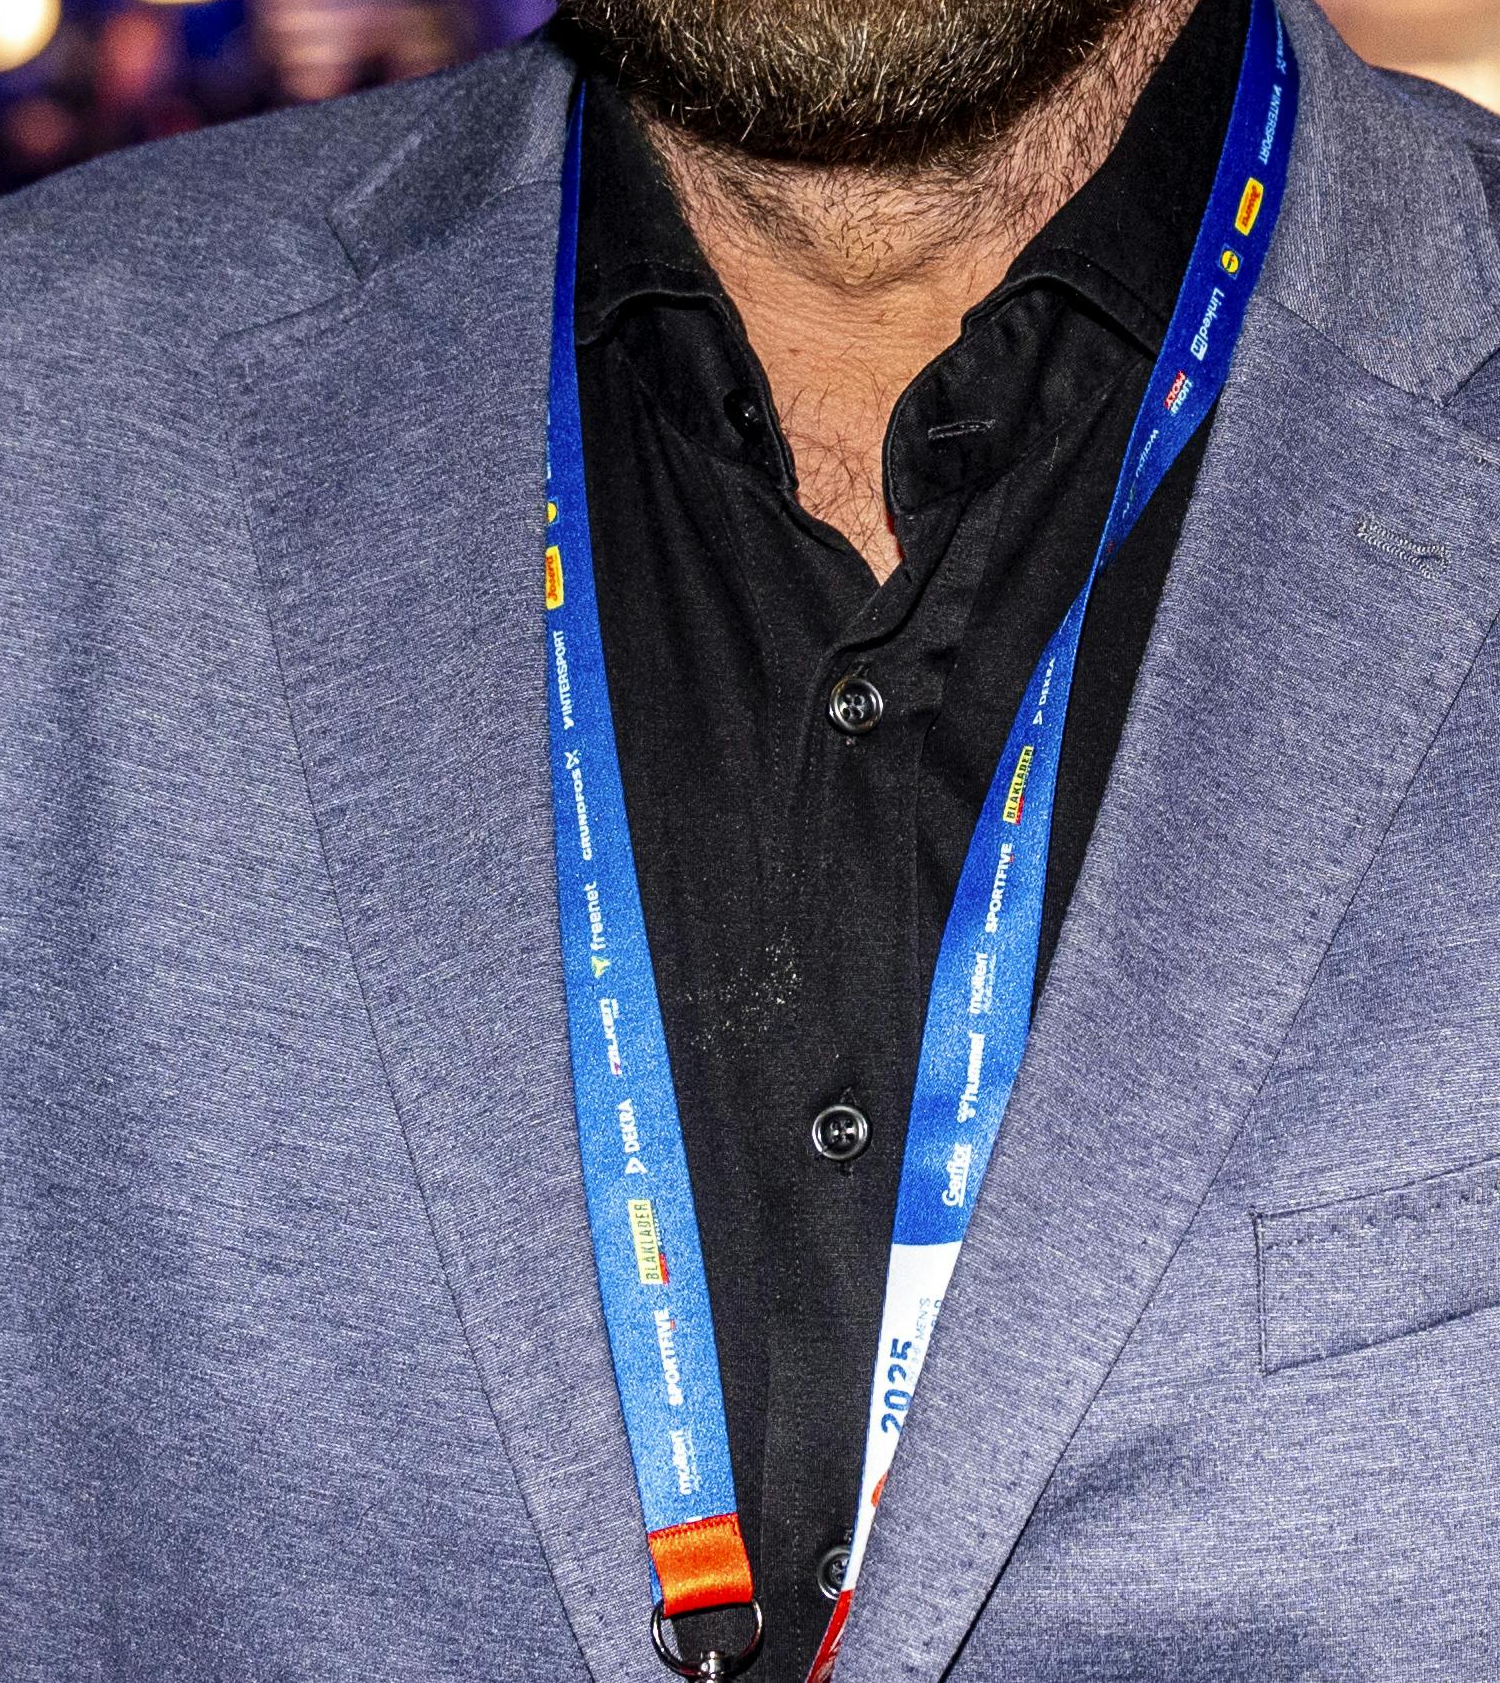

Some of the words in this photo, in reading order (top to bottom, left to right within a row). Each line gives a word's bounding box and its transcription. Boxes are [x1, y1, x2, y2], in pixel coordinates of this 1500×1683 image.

[570, 771, 592, 861] GRUNDFOS
[584, 881, 606, 951] freenet
[985, 843, 1013, 934] SPORTFIVE
[618, 1098, 640, 1153] DEKRA
[654, 1308, 685, 1406] SPORTFIVE
[881, 1338, 913, 1434] 2025
